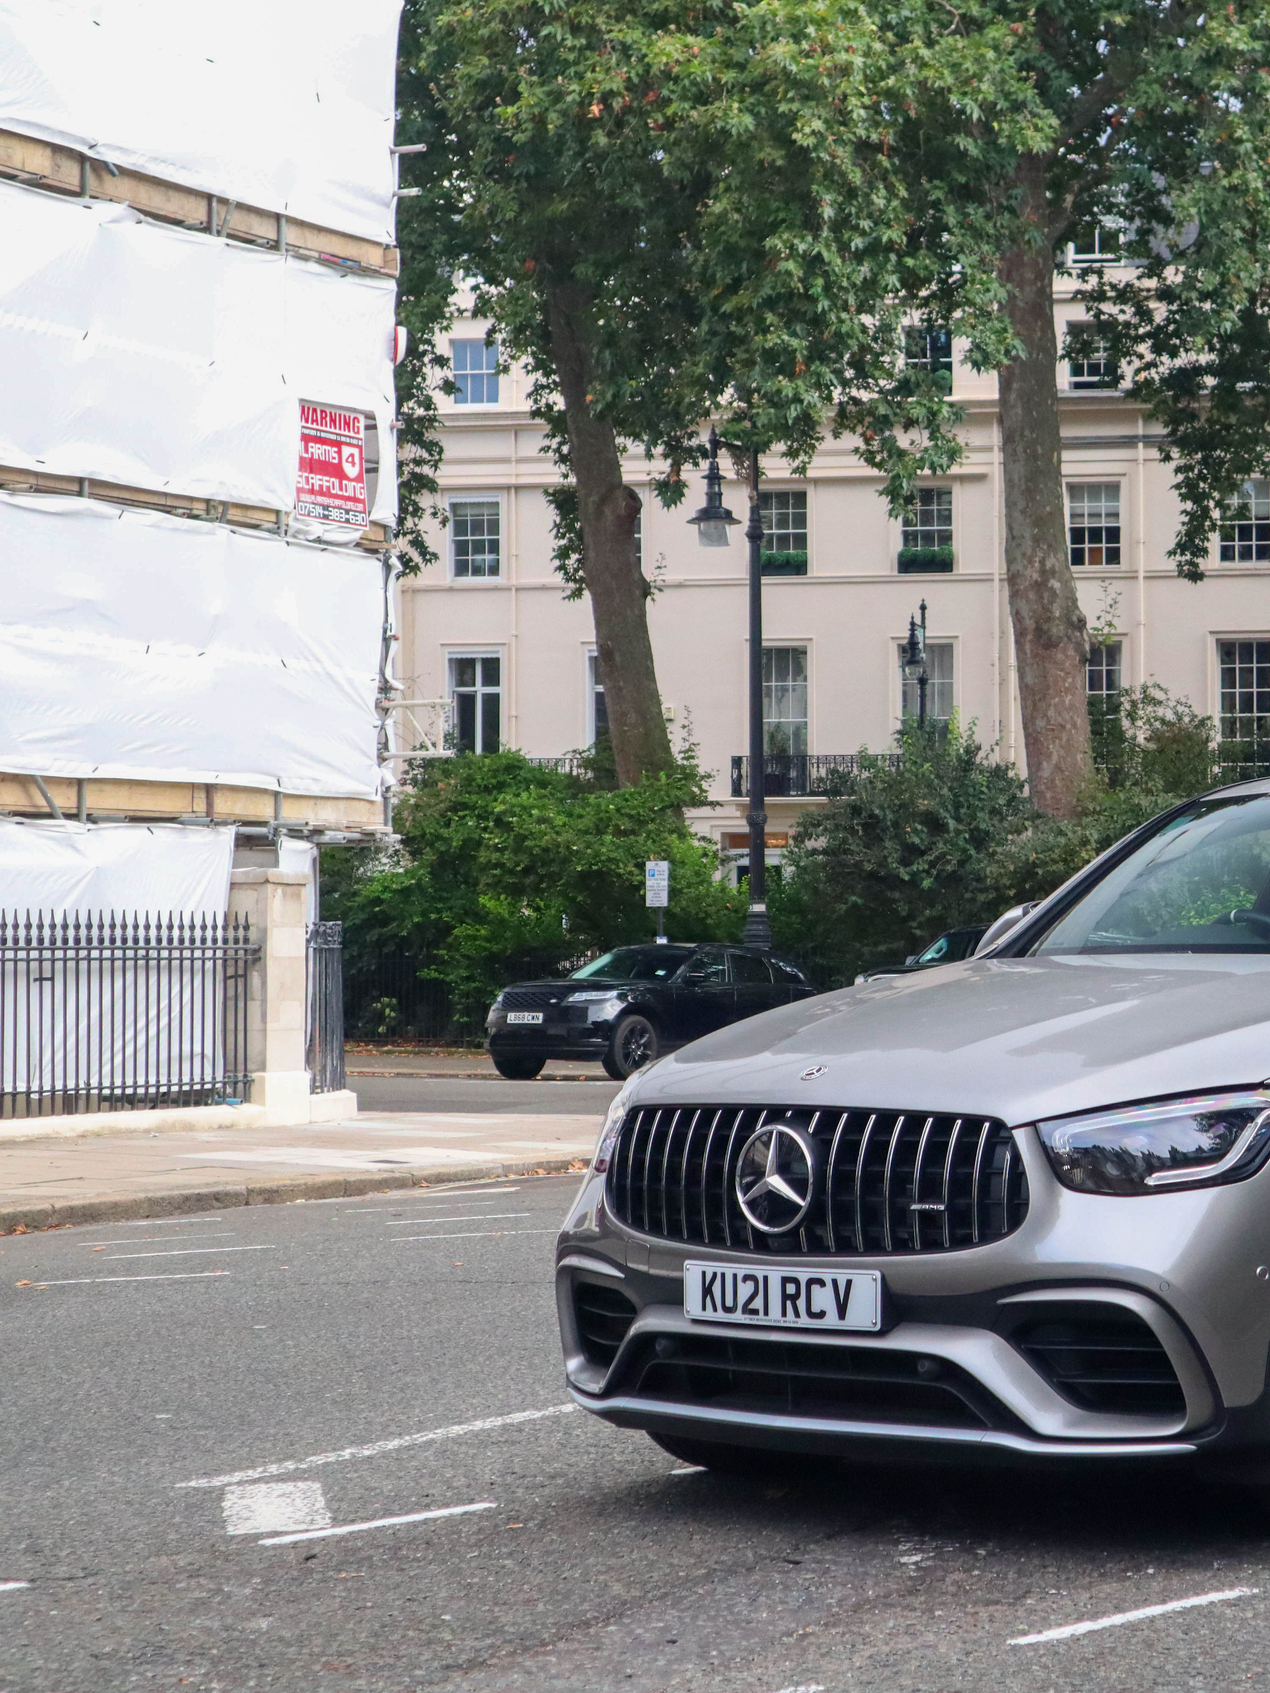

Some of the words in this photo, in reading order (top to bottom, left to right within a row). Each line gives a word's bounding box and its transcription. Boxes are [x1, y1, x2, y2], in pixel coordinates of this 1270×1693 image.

[345, 452, 356, 468] 4
[296, 472, 364, 499] SCAFFOLDING
[298, 502, 366, 525] 07514-383-630
[701, 1270, 769, 1317] KU21
[781, 1276, 853, 1321] RCV
